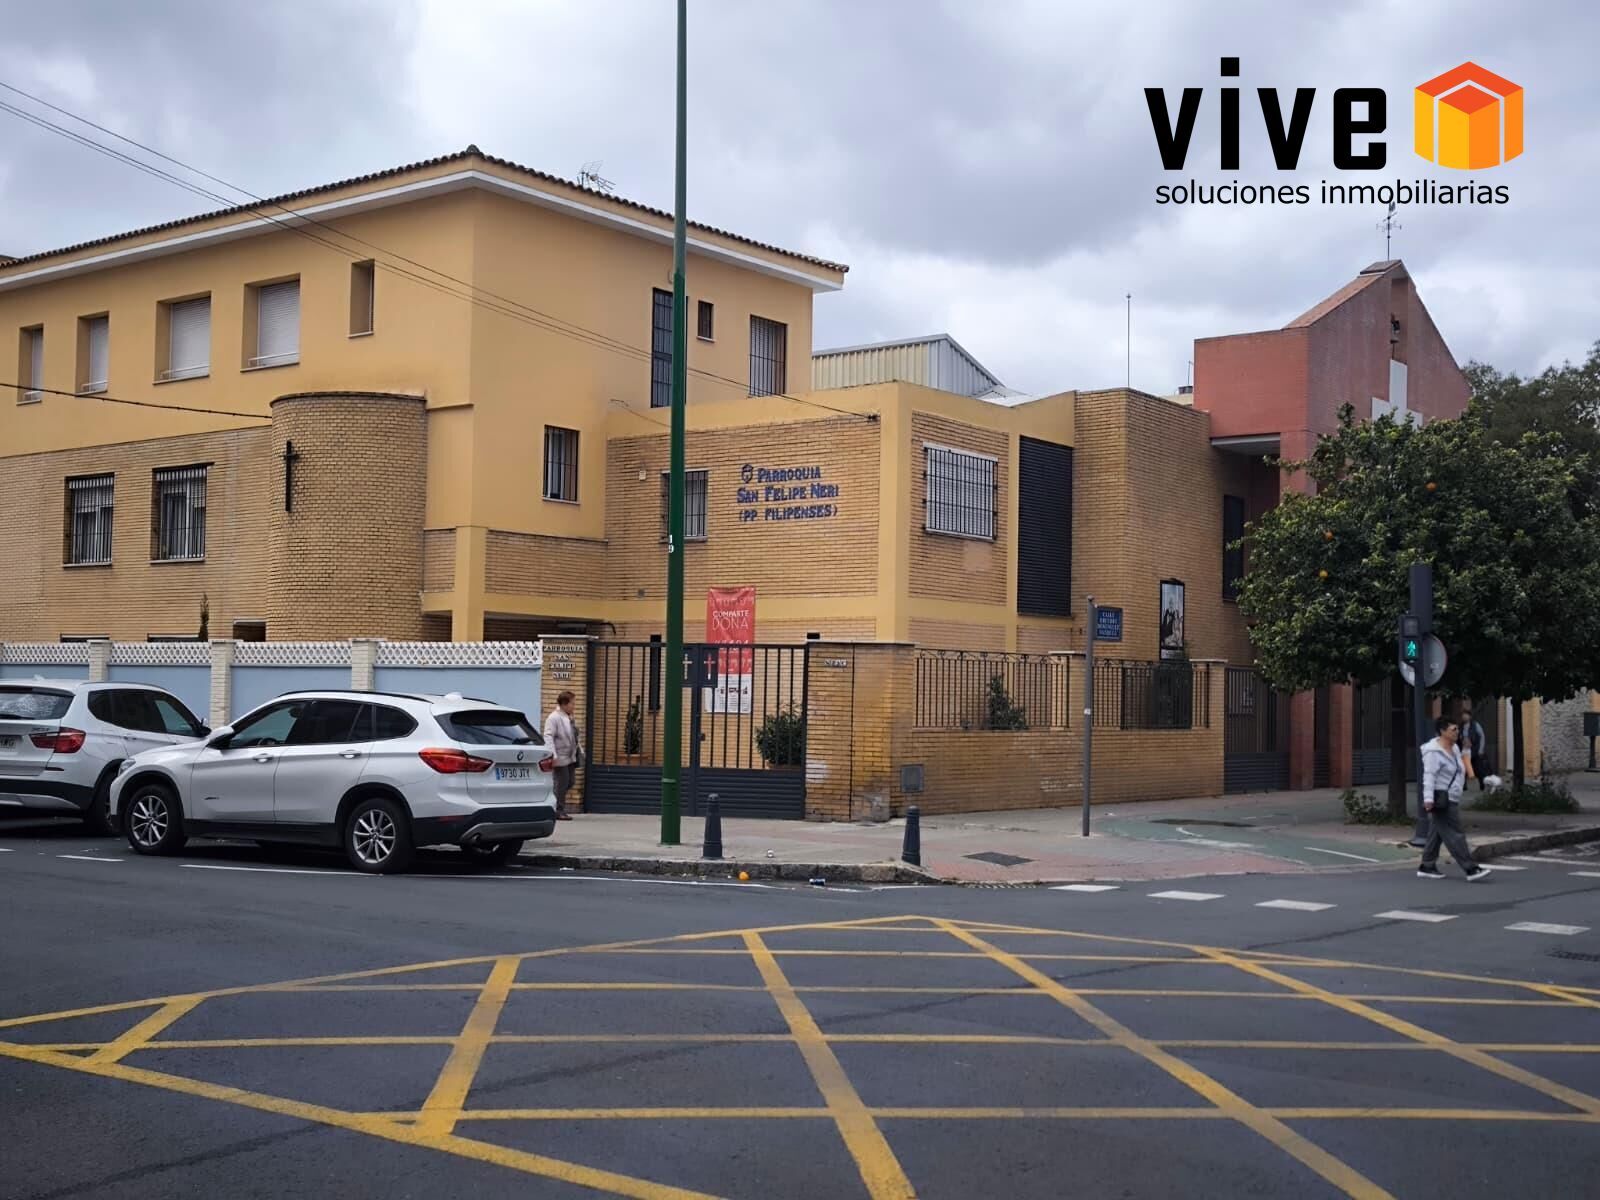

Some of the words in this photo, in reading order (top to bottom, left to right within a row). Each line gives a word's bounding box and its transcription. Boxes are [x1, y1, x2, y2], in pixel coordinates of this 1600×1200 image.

[757, 466, 821, 483] PARROQUIA
[737, 487, 759, 503] SAN
[765, 486, 807, 502] FELIPE
[811, 483, 839, 498] NERI
[765, 504, 838, 520] FILIPENSES)
[712, 610, 750, 618] COMPARTE
[712, 617, 749, 630] DONA
